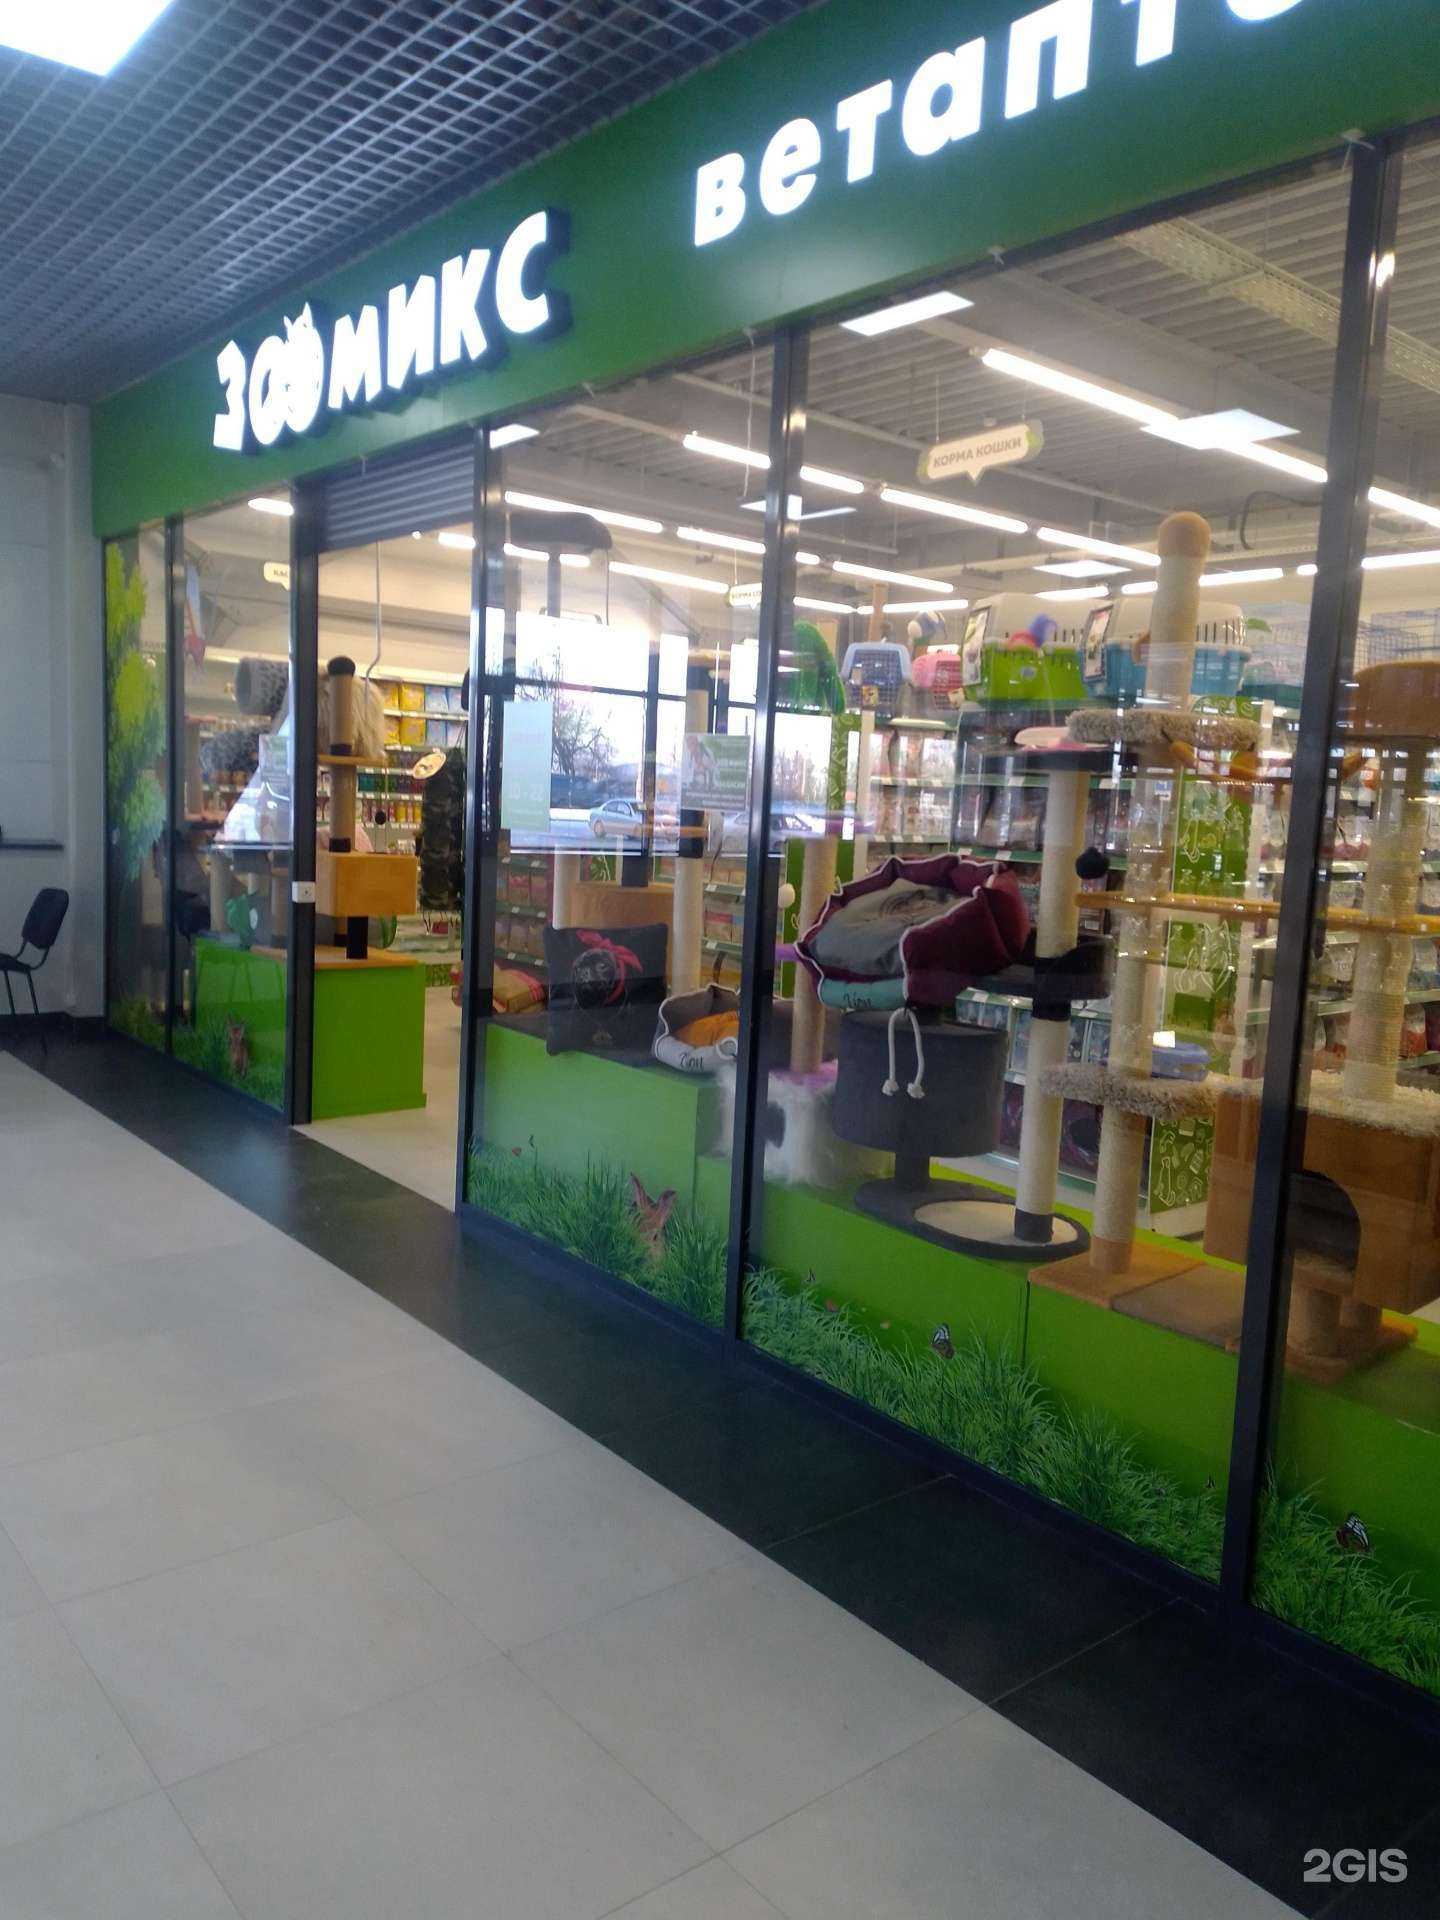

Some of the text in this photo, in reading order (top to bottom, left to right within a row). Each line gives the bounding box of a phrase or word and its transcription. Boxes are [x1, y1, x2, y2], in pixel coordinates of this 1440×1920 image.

[694, 0, 1301, 248] ветапт
[933, 437, 1022, 468] КОРМА КОШКИ
